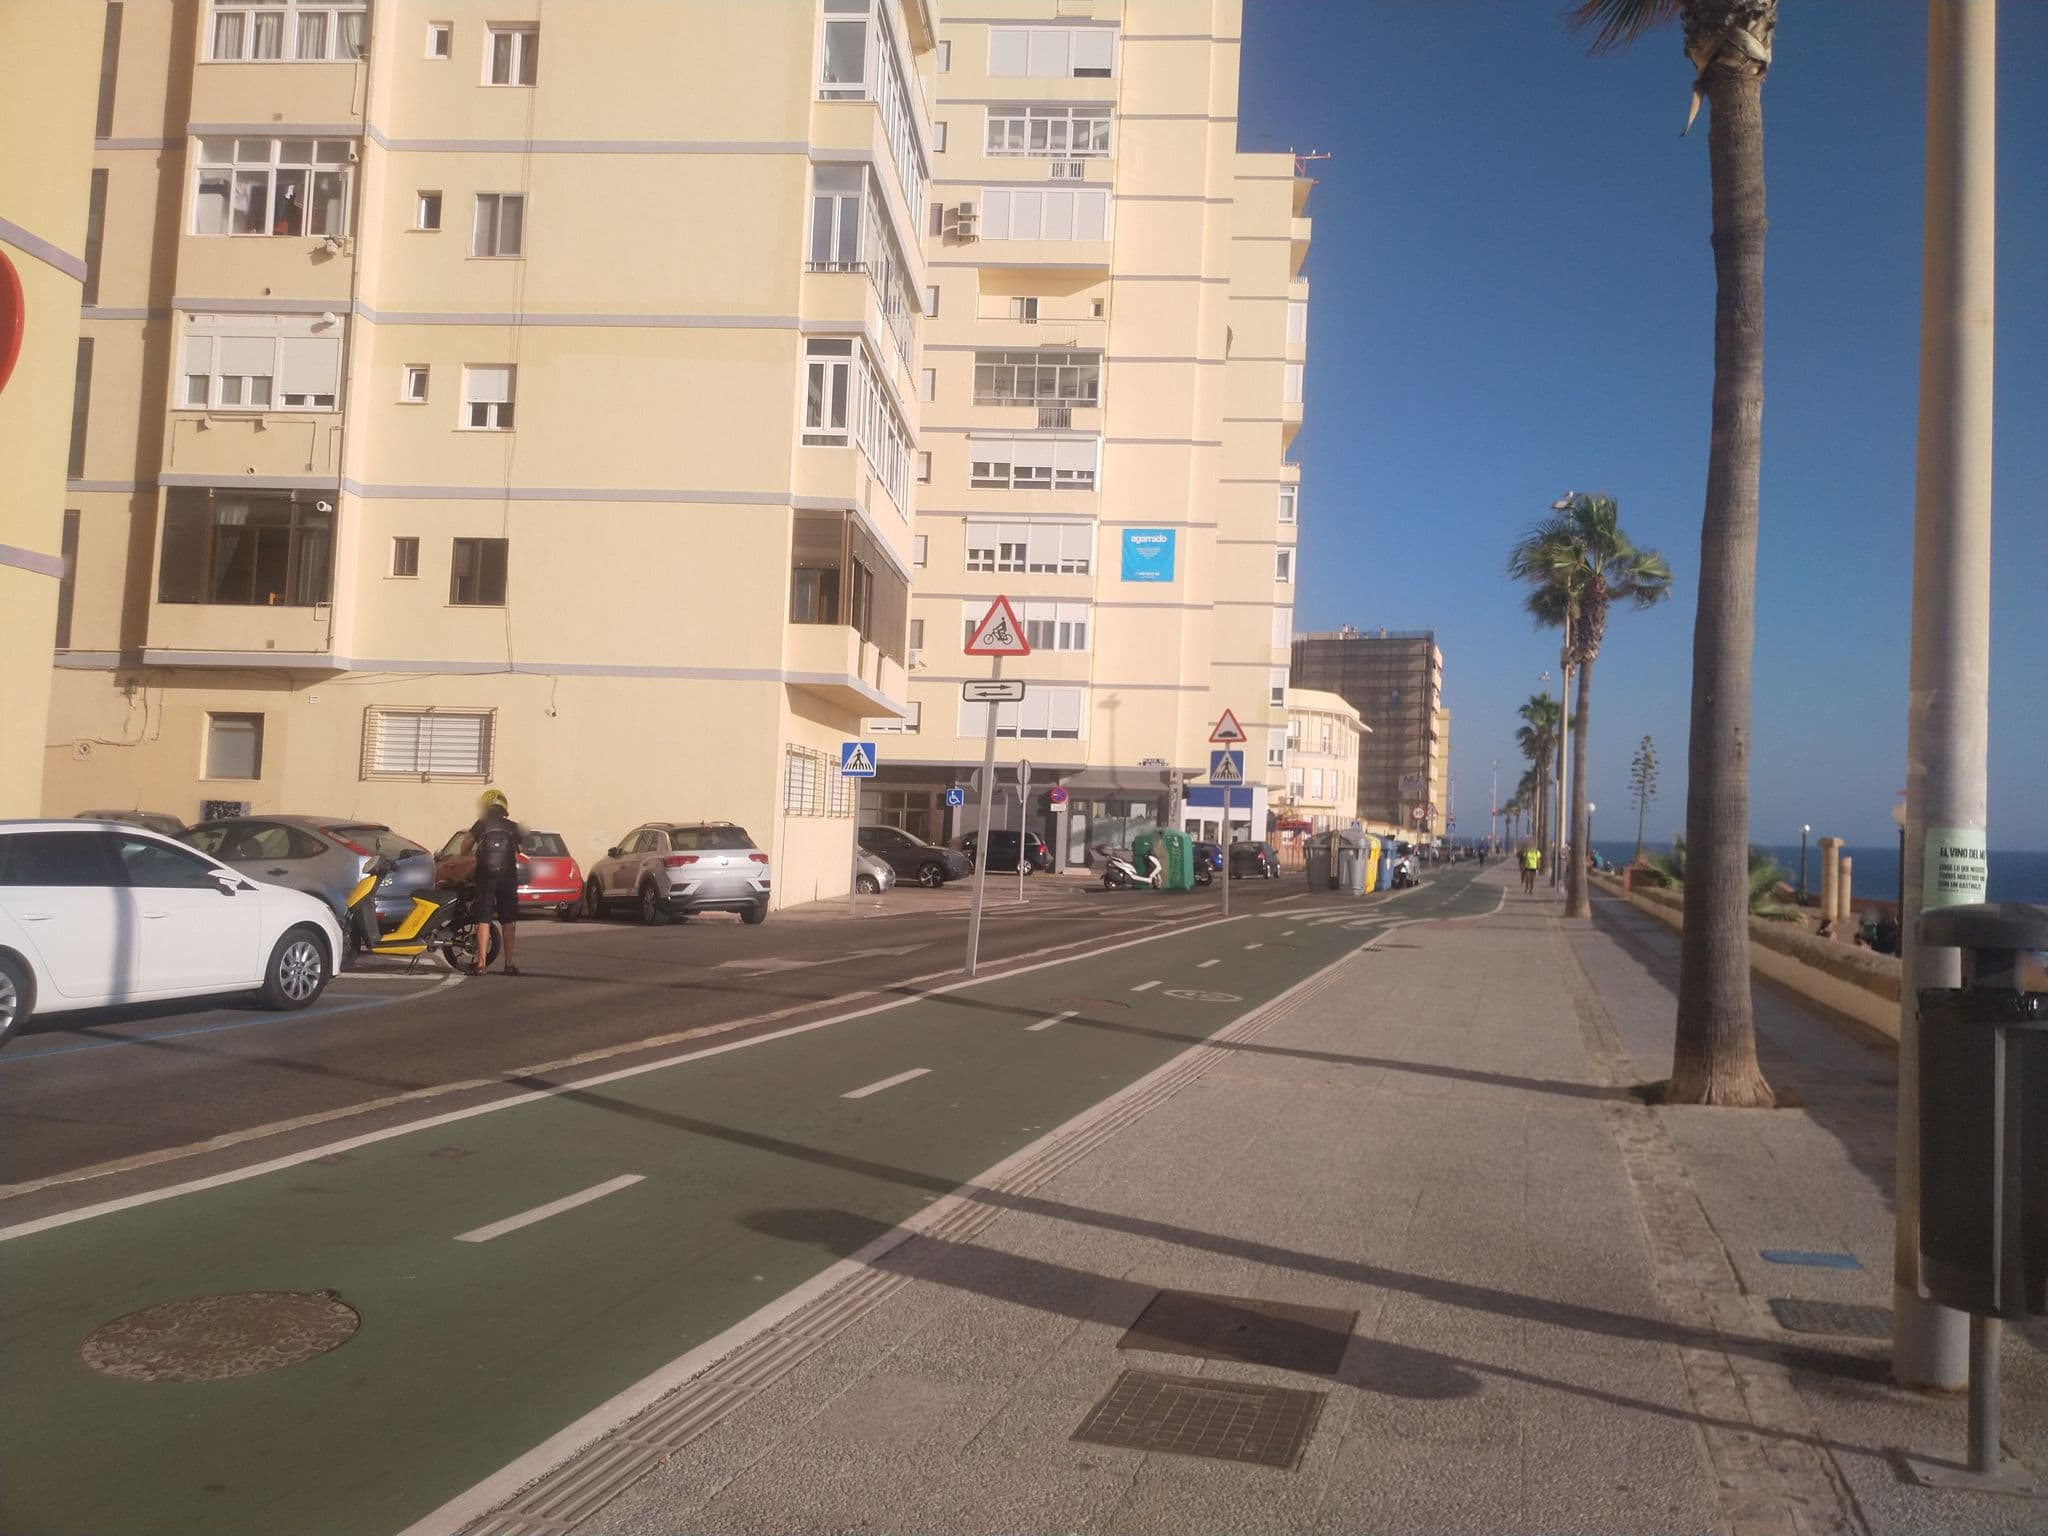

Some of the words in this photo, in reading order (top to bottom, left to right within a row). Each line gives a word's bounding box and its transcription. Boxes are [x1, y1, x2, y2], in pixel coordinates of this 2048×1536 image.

[1940, 847, 1948, 857] EL
[1950, 847, 1968, 858] VINO
[1969, 848, 1978, 859] DEL
